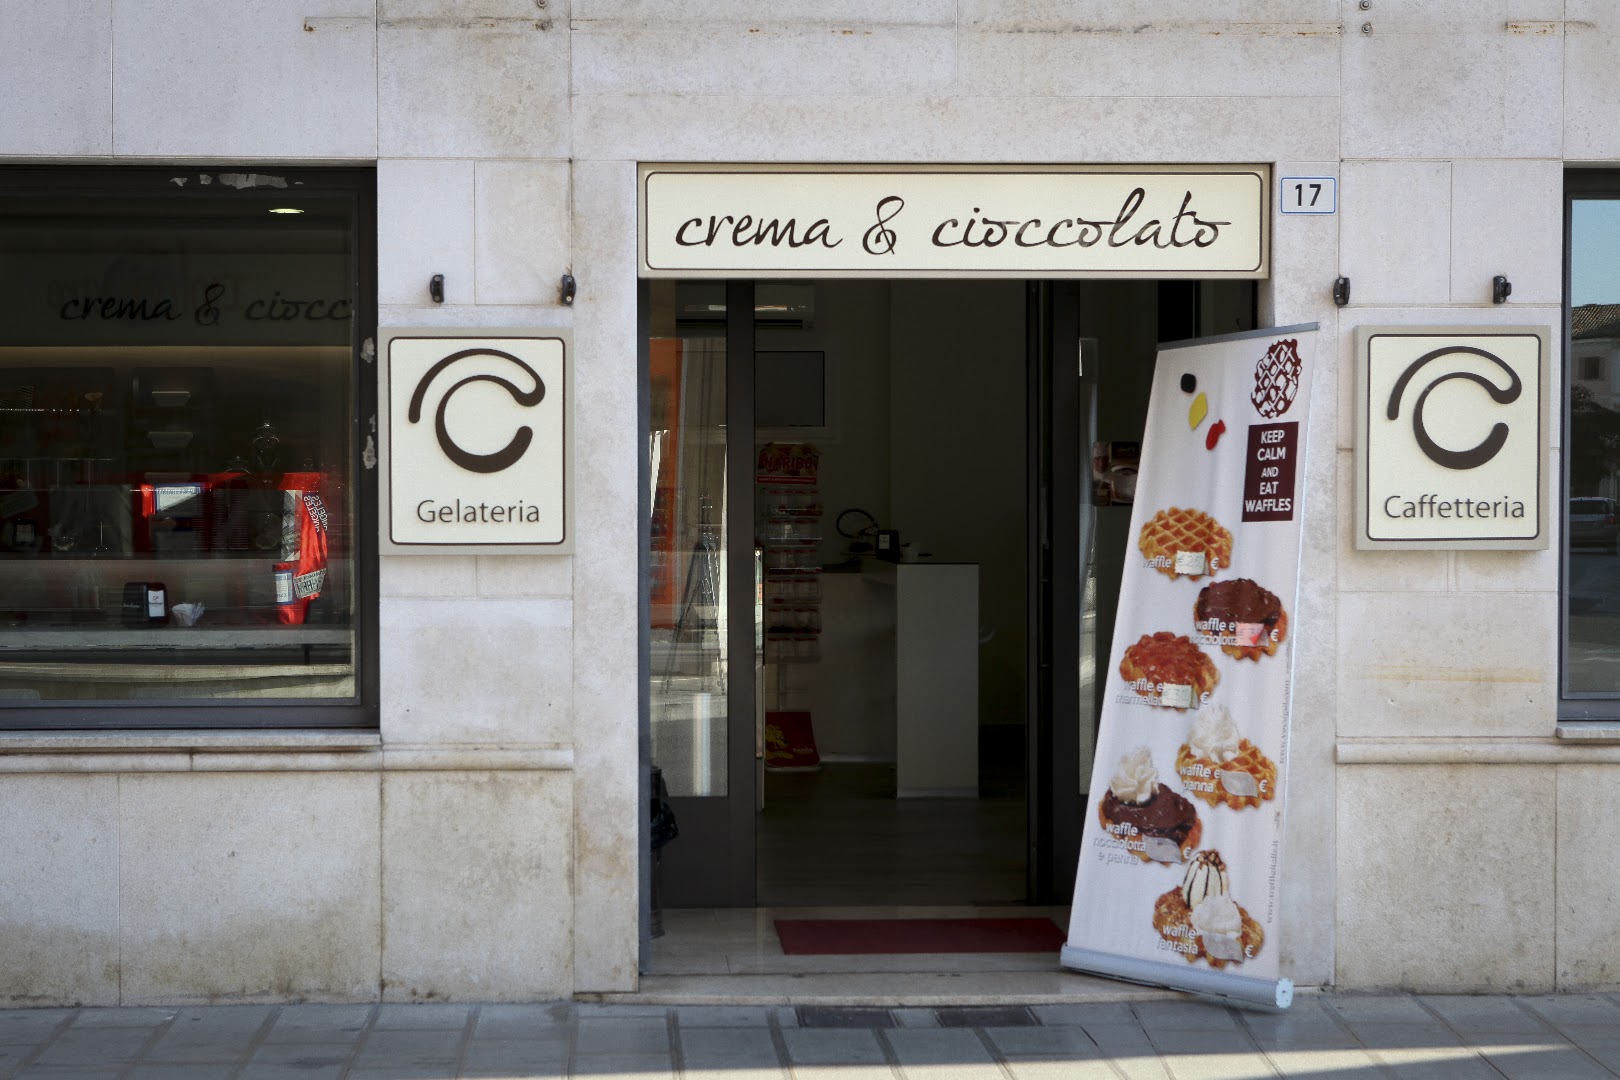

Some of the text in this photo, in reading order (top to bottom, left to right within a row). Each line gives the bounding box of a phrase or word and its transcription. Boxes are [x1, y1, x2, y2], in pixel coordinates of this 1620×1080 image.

[1296, 184, 1321, 206] 17
[676, 188, 1231, 255] crema & cioccolato
[59, 295, 181, 321] crema
[195, 284, 226, 326] &
[1261, 430, 1284, 443] KEEP
[1257, 447, 1285, 460] CALM
[1261, 467, 1278, 477] AND
[1260, 482, 1278, 494] EAT
[417, 499, 539, 523] Gelateria
[1245, 498, 1291, 512] WAFFLES
[1385, 494, 1524, 519] Caffetteria
[1143, 555, 1171, 568] waffle
[1210, 557, 1219, 570] €
[1195, 618, 1227, 632] waffle
[1228, 622, 1236, 632] e
[1270, 629, 1279, 642] €
[1200, 691, 1209, 705] €
[1179, 764, 1267, 793] waffle e €
[1183, 780, 1215, 795] panna
[1105, 822, 1192, 860] waffle €
[1162, 924, 1254, 959] waffle €
